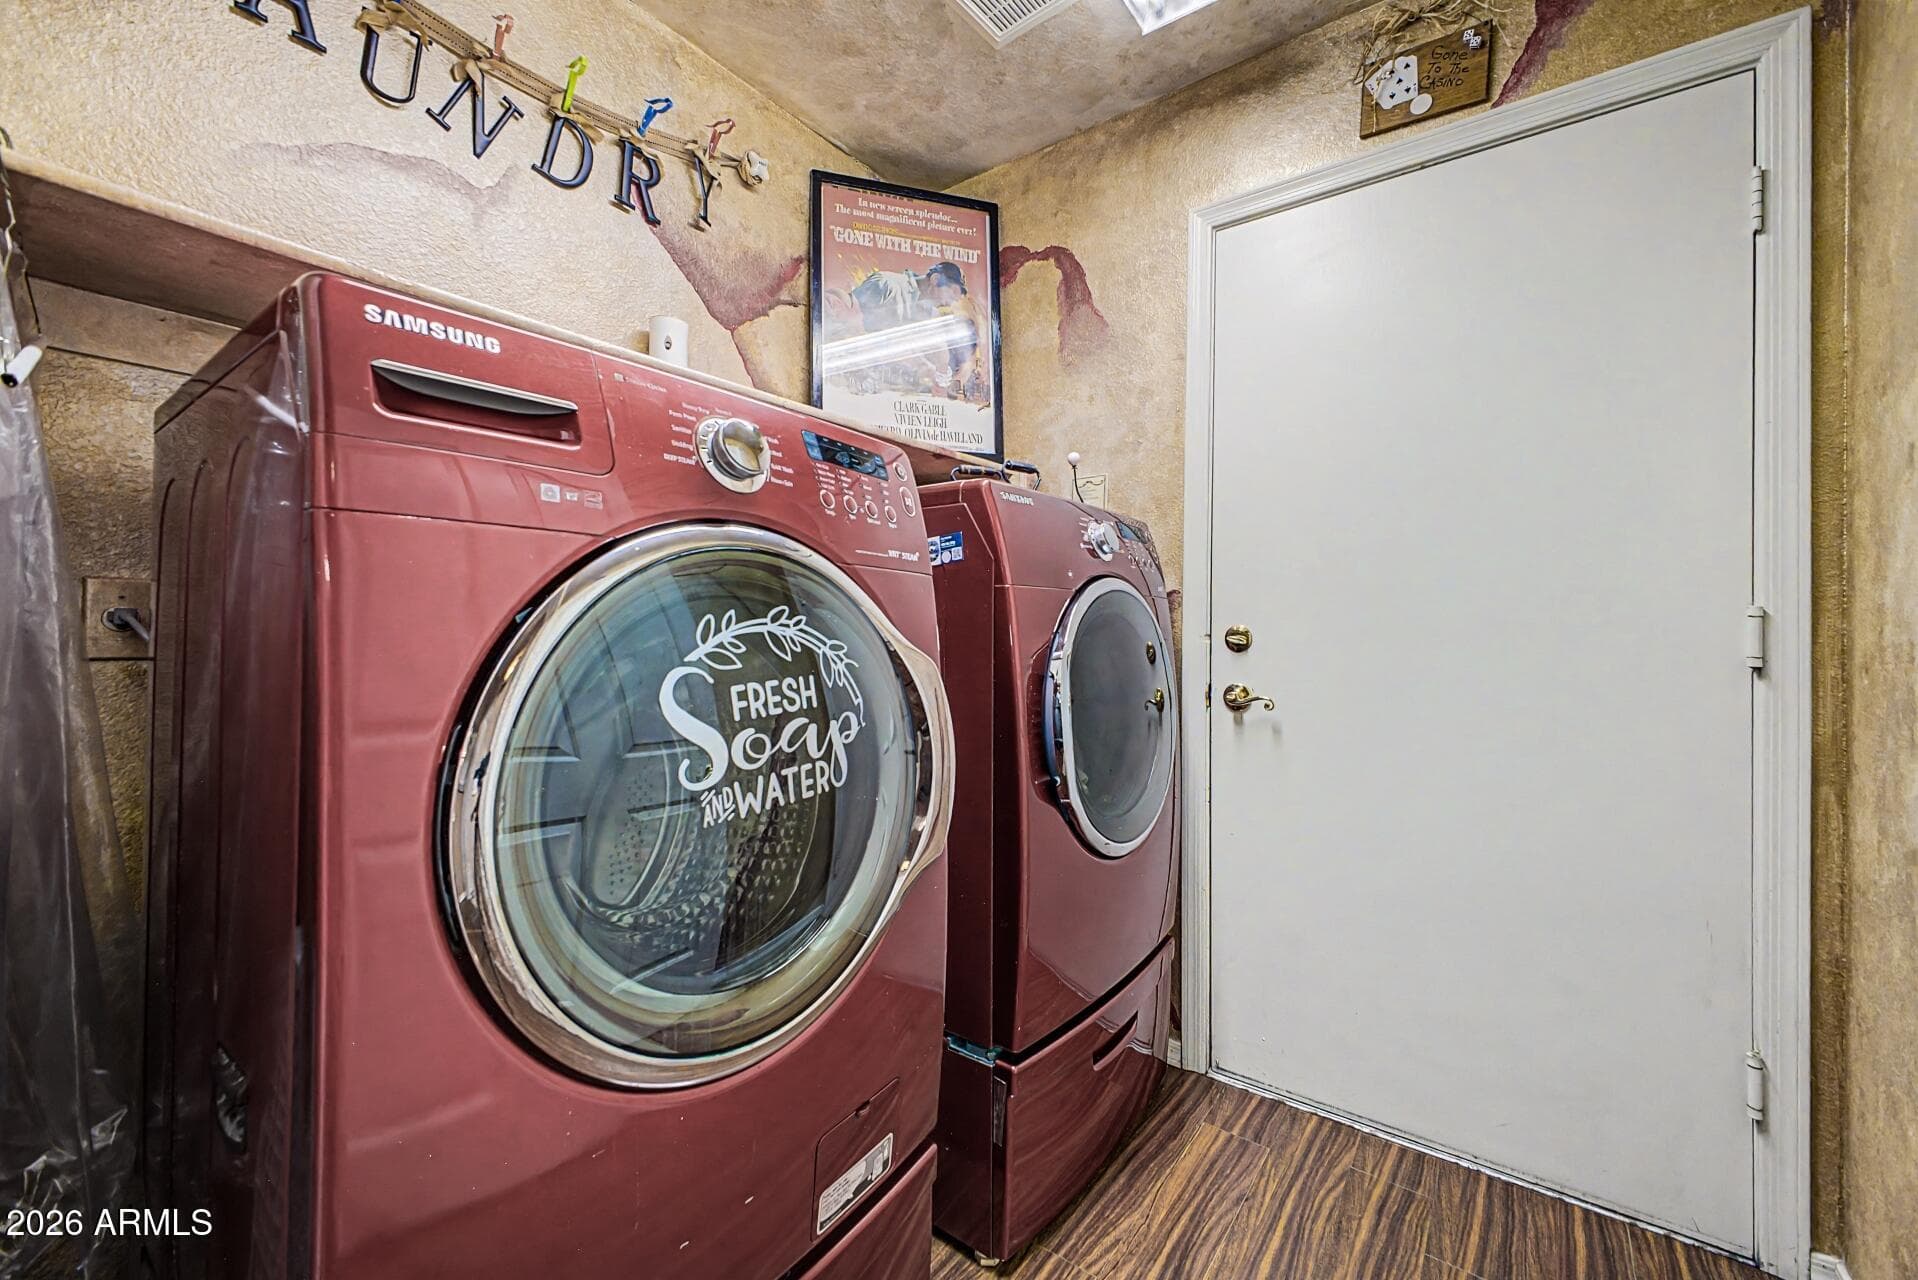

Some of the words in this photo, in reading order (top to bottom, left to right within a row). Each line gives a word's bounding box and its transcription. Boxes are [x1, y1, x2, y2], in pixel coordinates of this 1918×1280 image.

[1431, 45, 1469, 60] Gone
[1427, 62, 1442, 74] To
[1450, 62, 1470, 74] The
[858, 197, 869, 208] In
[834, 203, 851, 215] The
[853, 208, 875, 219] most
[876, 211, 926, 228] magnificent
[927, 220, 956, 233] picture
[875, 233, 912, 254] WITH
[913, 239, 942, 259] THE
[363, 303, 502, 355] SAMSUNG
[893, 400, 921, 414] CLARK
[921, 402, 948, 417] GABLE
[894, 413, 923, 427] VIVIEN
[923, 416, 949, 429] LEIGH
[730, 674, 818, 722] FRESH
[658, 666, 859, 792] Soap
[702, 786, 736, 829] AND
[733, 759, 831, 820] WATER
